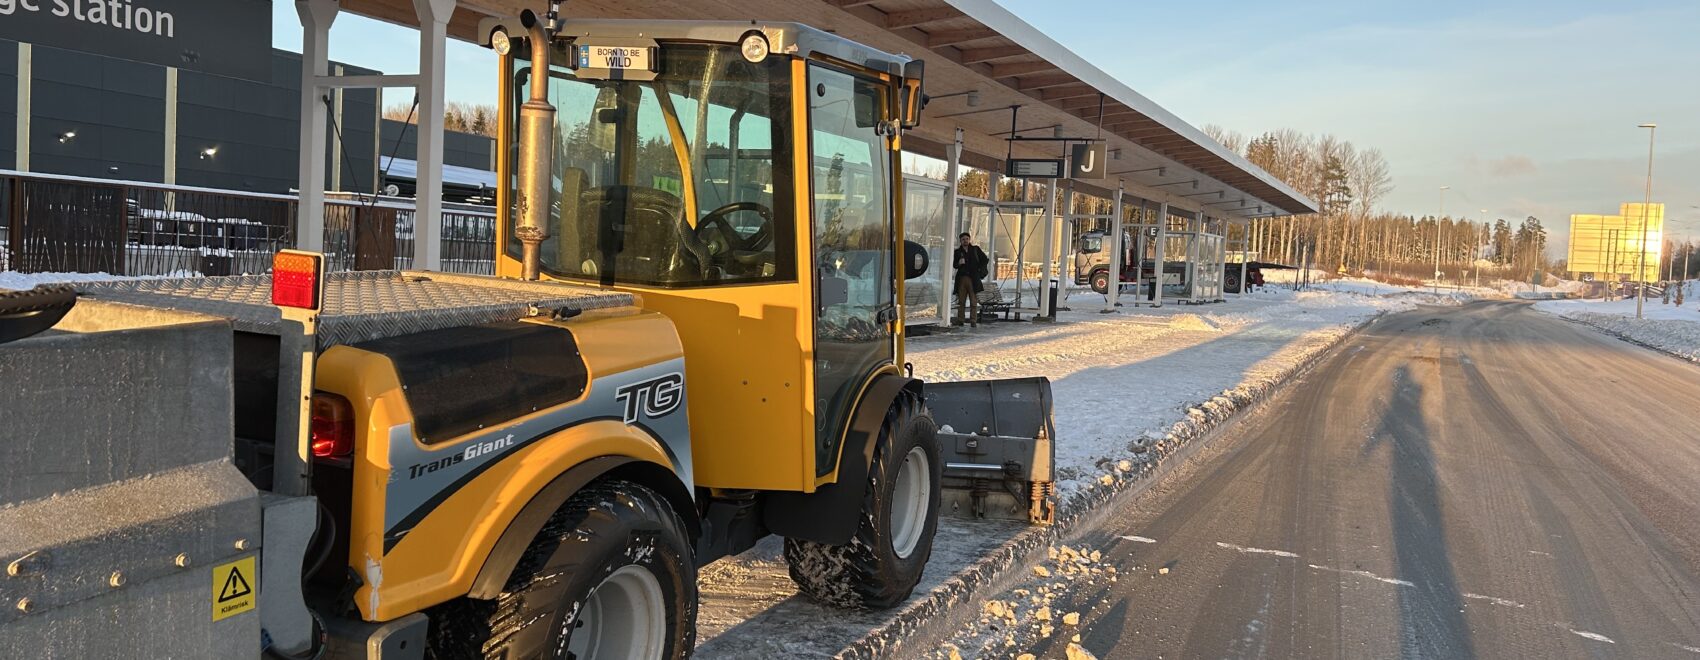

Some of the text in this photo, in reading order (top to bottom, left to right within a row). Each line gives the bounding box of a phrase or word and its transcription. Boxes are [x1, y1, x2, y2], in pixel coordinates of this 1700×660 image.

[51, 0, 174, 38] station
[597, 48, 640, 57] BORN TO BE
[605, 57, 632, 68] WILD
[1080, 150, 1095, 173] J
[615, 372, 683, 424] TG
[408, 433, 514, 480] TransGiant
